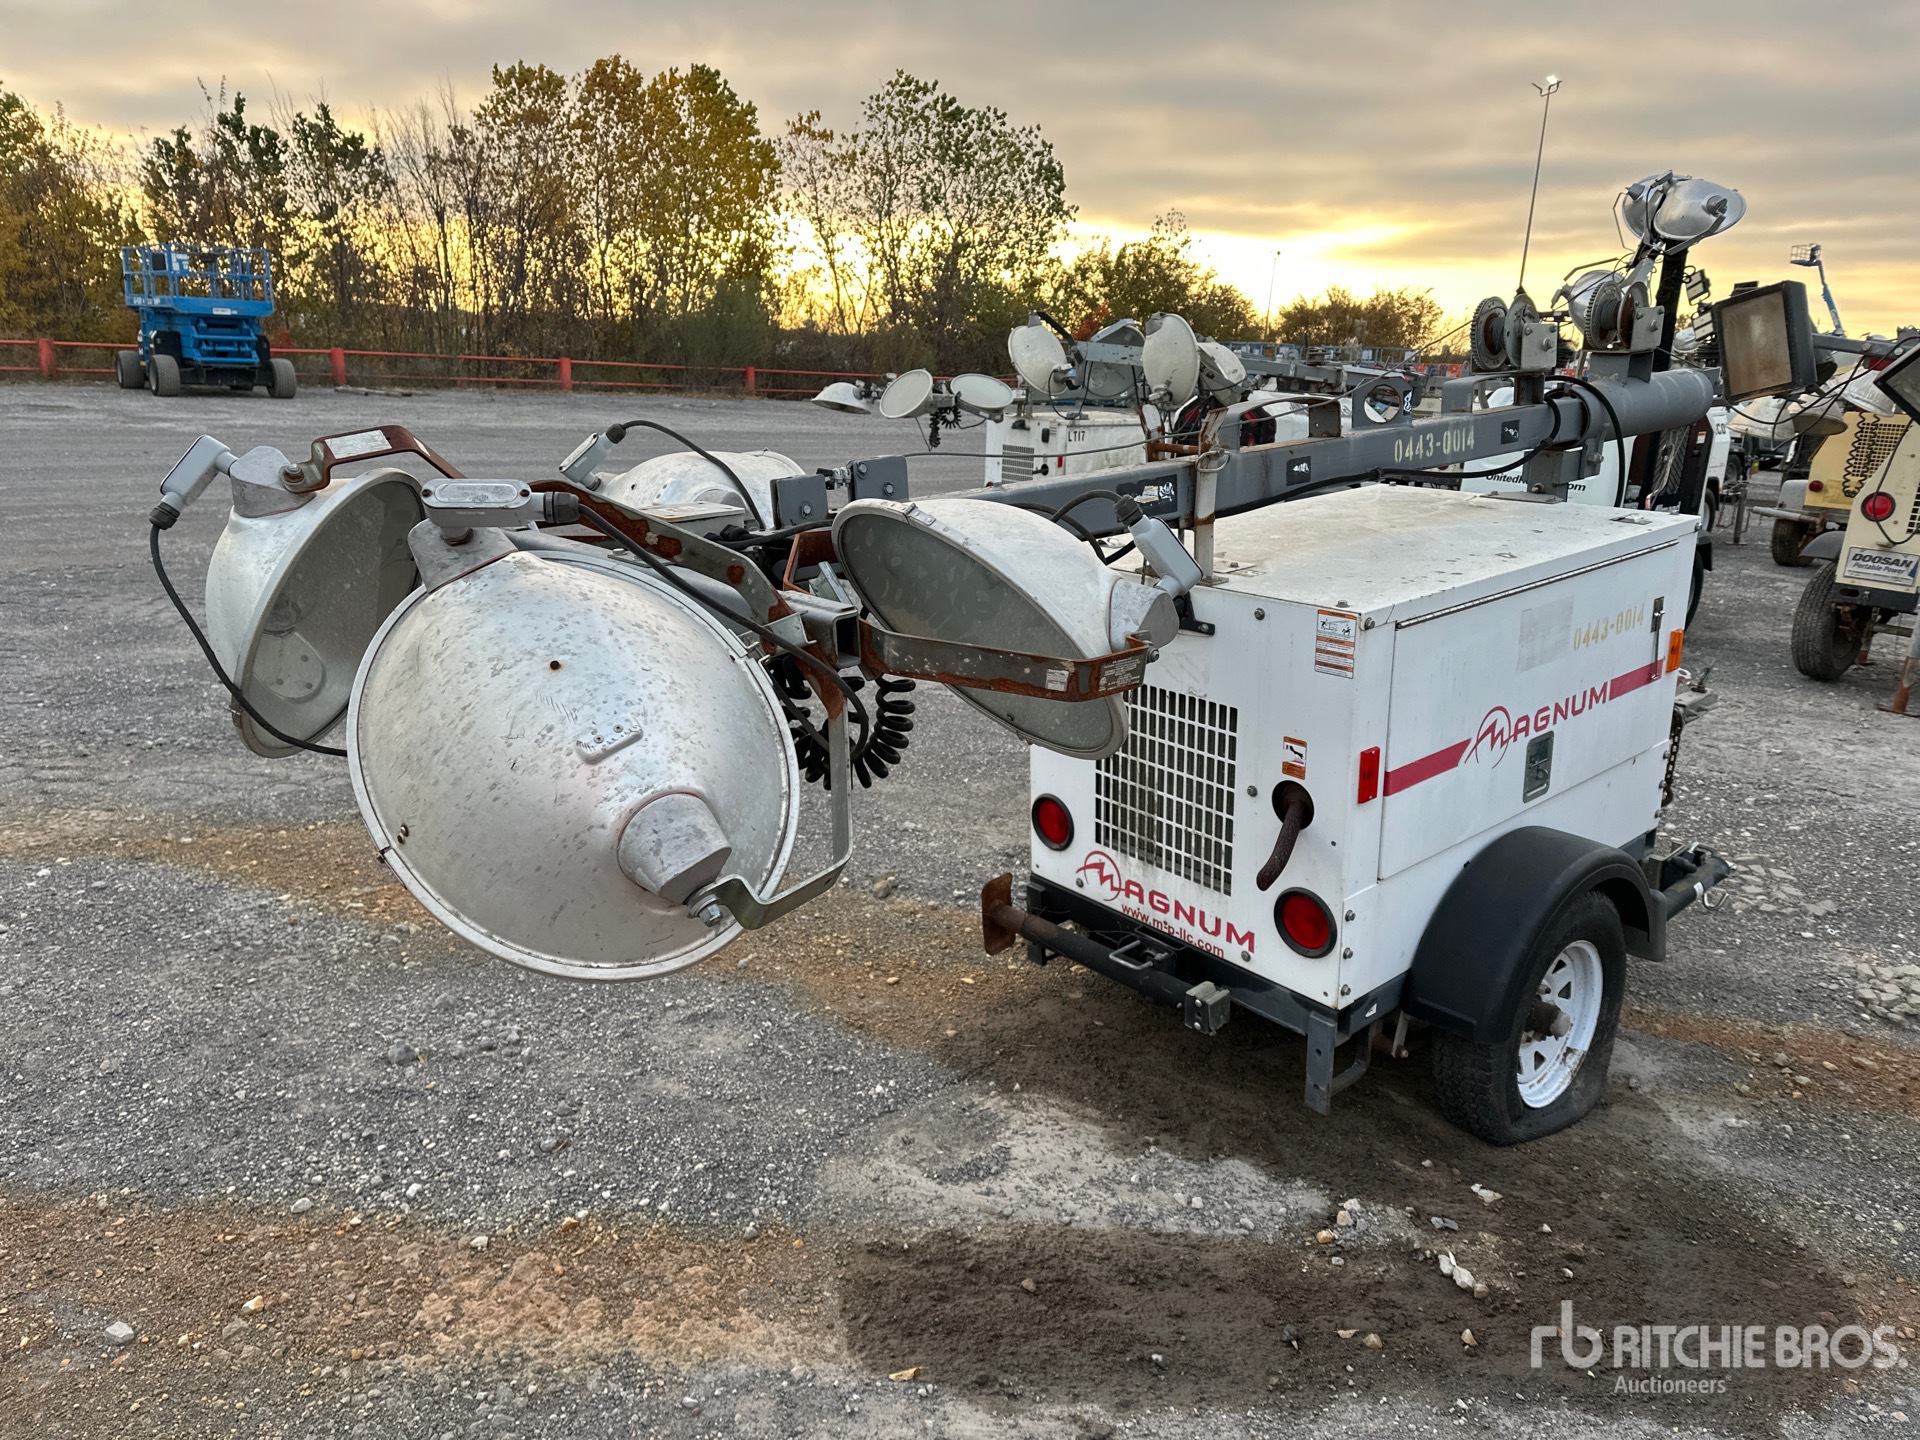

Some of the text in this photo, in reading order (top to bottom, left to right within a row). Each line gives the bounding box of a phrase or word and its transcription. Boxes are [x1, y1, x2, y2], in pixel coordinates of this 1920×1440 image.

[1067, 430, 1086, 442] LT17
[1394, 425, 1475, 463] 0443-0014
[1851, 553, 1914, 568] DOOSAN
[1852, 561, 1883, 571] Portable
[1573, 602, 1645, 651] 0443-0014
[1464, 681, 1608, 769] MAGNUM
[1076, 851, 1255, 954] MAGNUM
